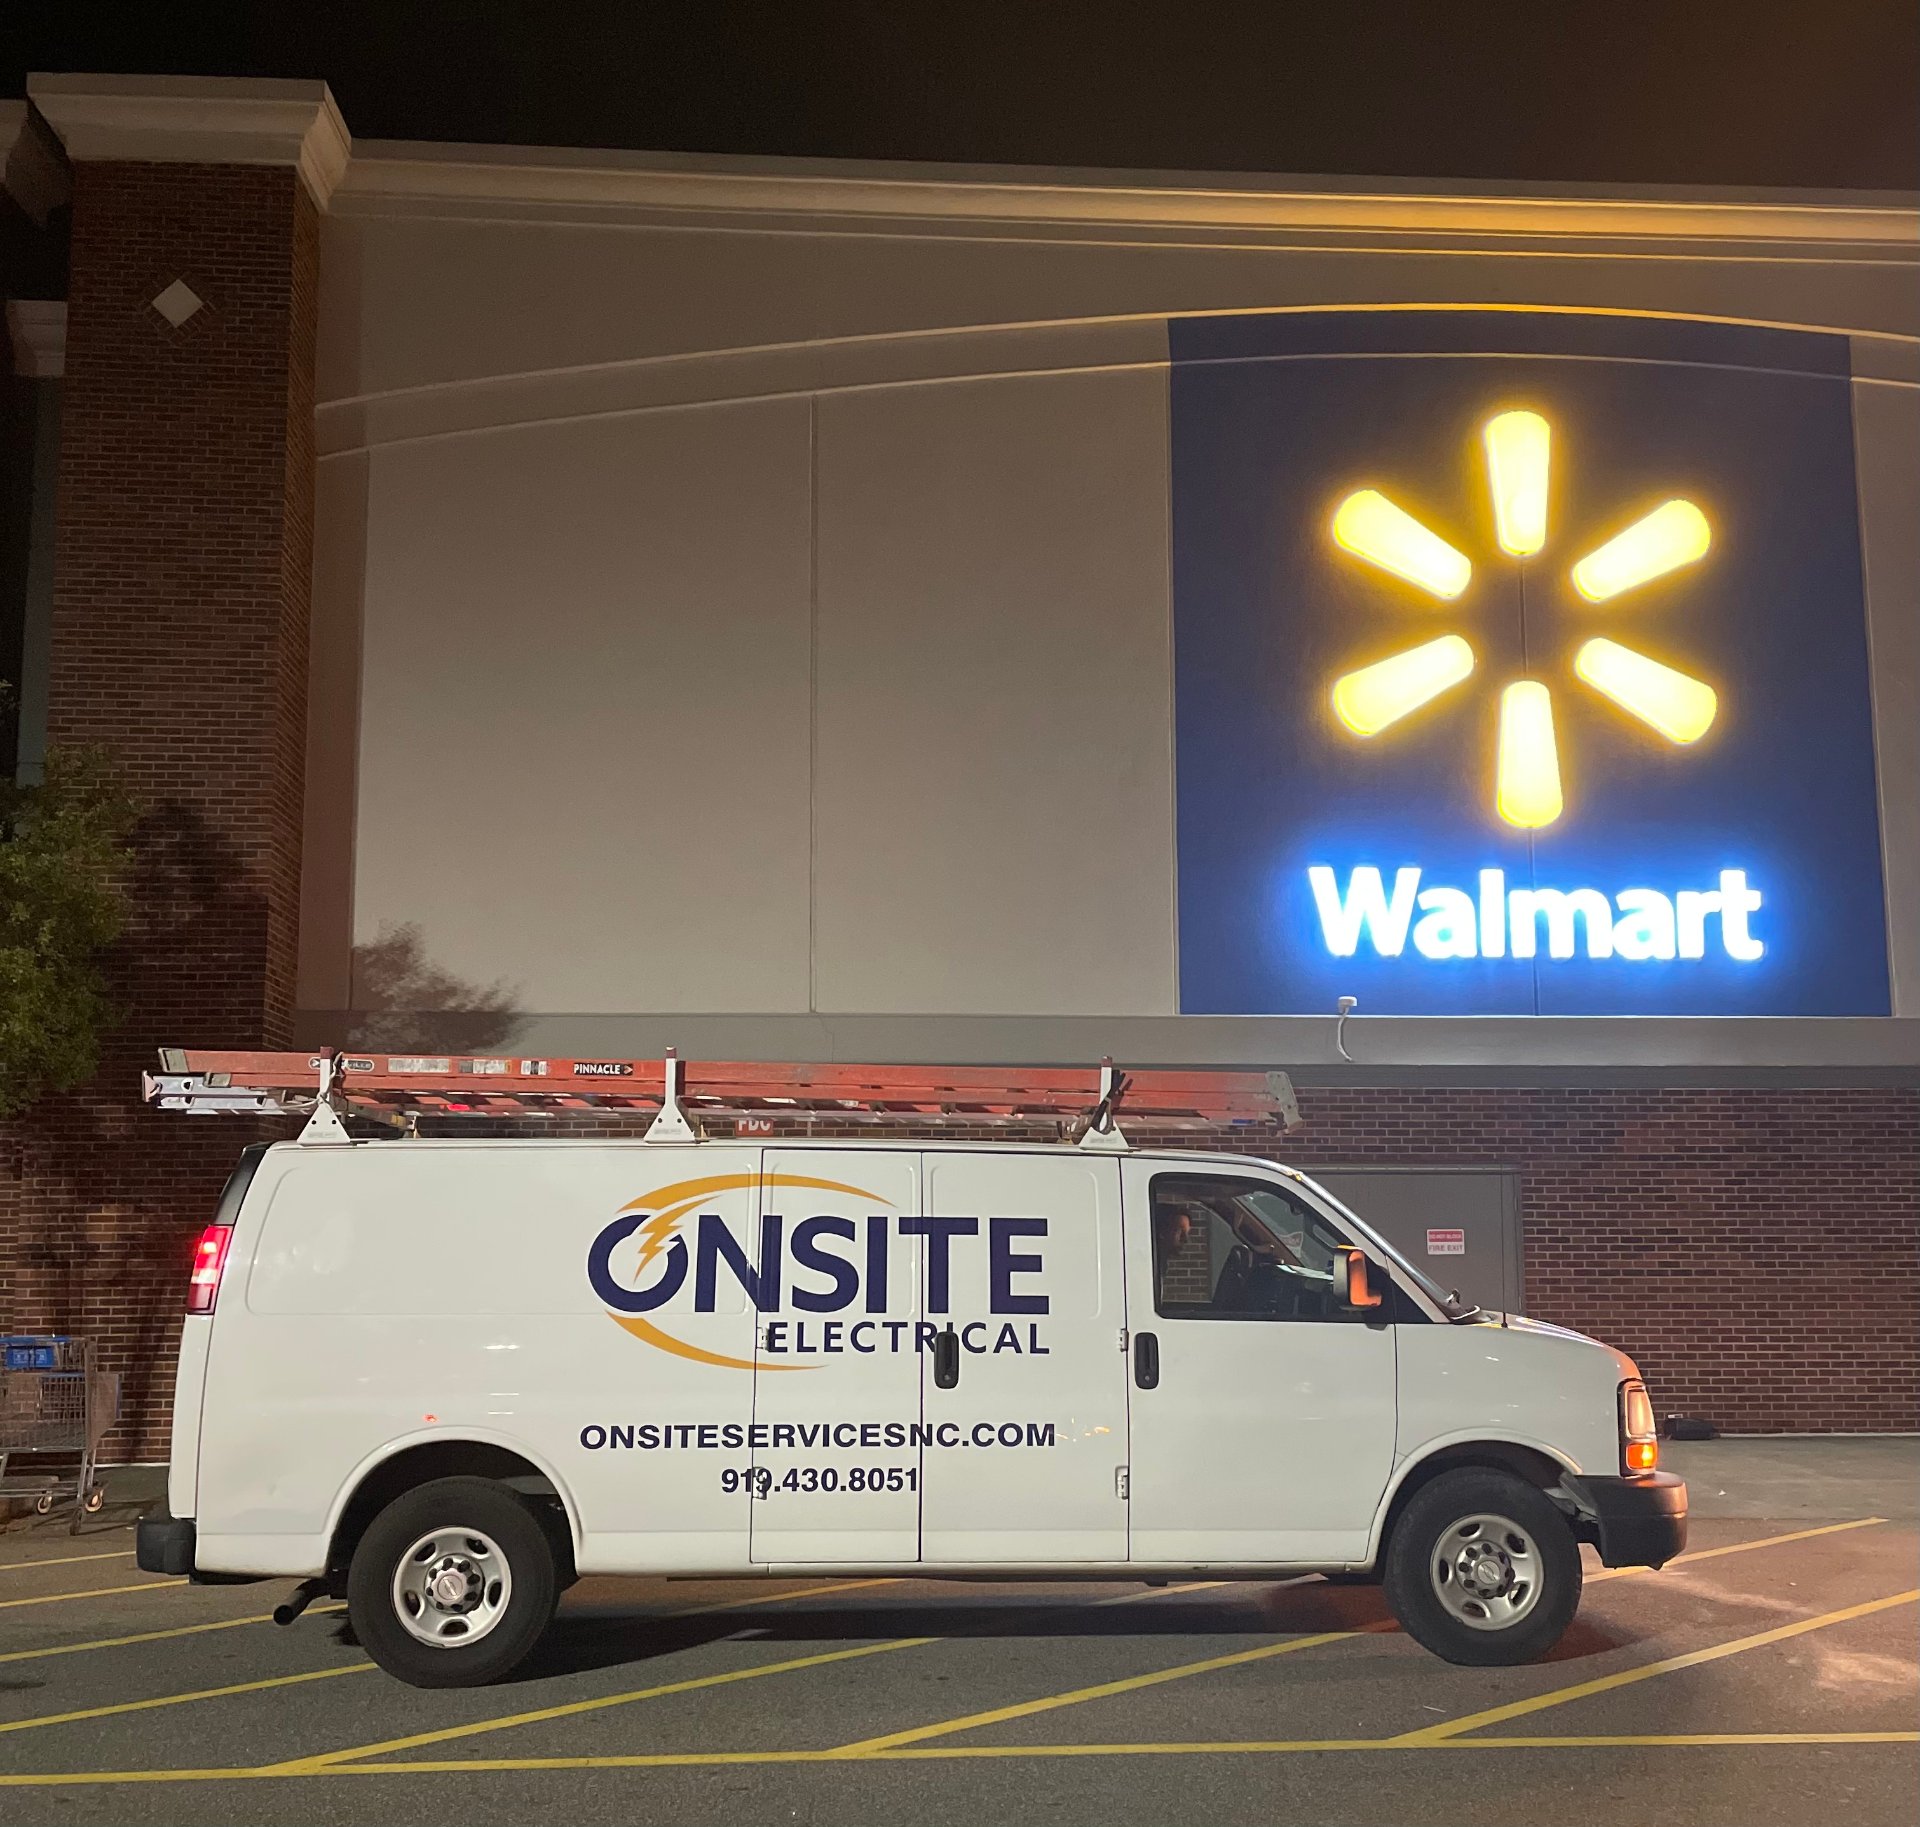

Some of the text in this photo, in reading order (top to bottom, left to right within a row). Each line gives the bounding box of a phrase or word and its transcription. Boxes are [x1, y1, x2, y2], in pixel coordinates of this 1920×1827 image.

[1308, 866, 1764, 961] Walmart
[573, 1063, 621, 1075] PINNACLE
[738, 1119, 771, 1131] FDC
[587, 1214, 1050, 1315] ONSITE
[580, 1423, 1056, 1450] ONSITESERVICESNC.COM
[721, 1467, 918, 1493] 919.430.8051
